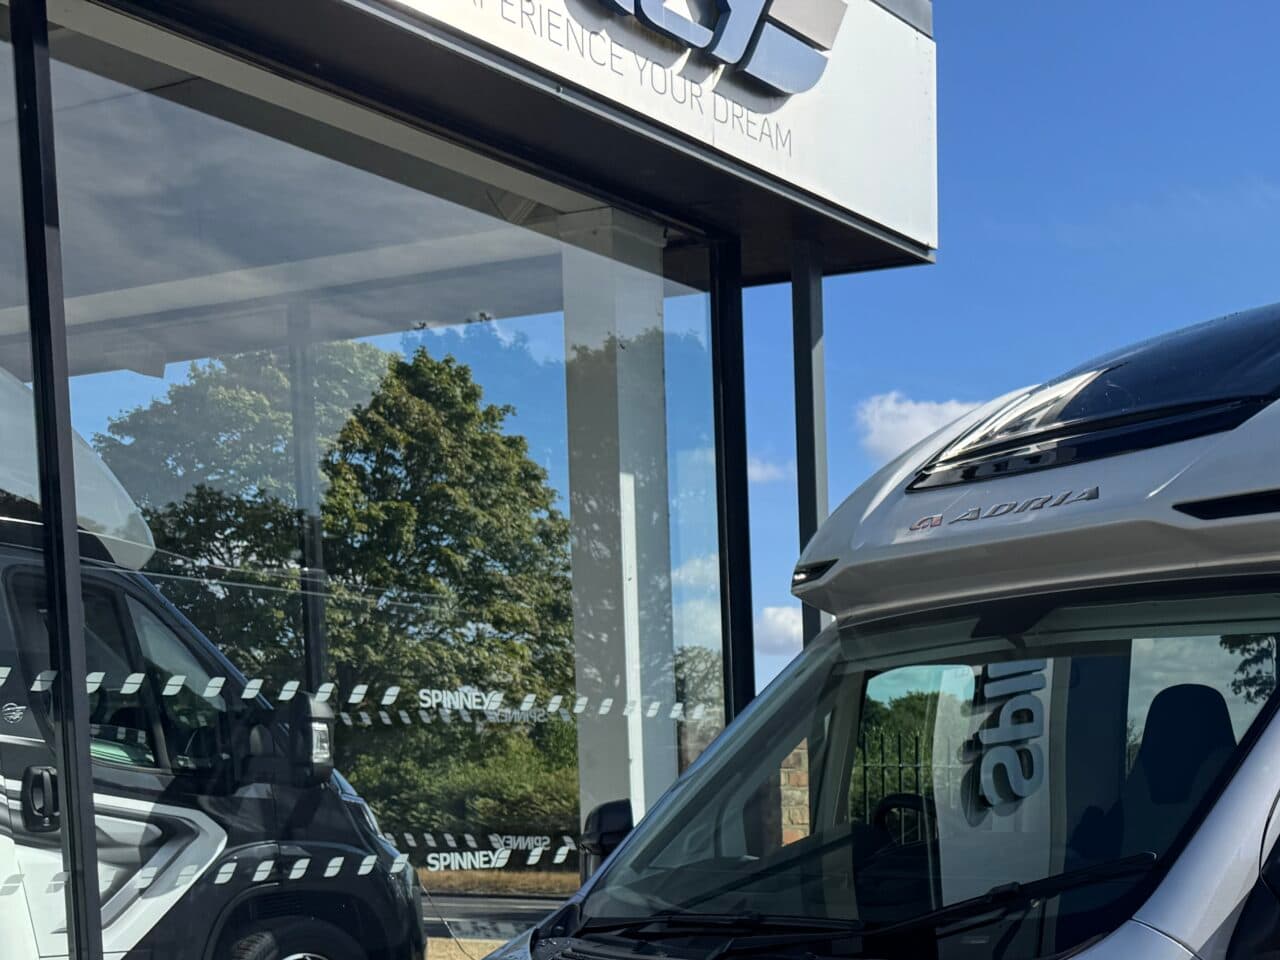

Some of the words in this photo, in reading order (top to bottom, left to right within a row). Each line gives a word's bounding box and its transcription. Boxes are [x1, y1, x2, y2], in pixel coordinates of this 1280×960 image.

[473, 0, 624, 76] ERIENCE
[632, 50, 704, 115] YOUR
[712, 88, 793, 158] DREAM
[948, 486, 1100, 525] ADRIA
[418, 688, 495, 710] SPINNEY
[426, 849, 499, 871] SPINNEY
